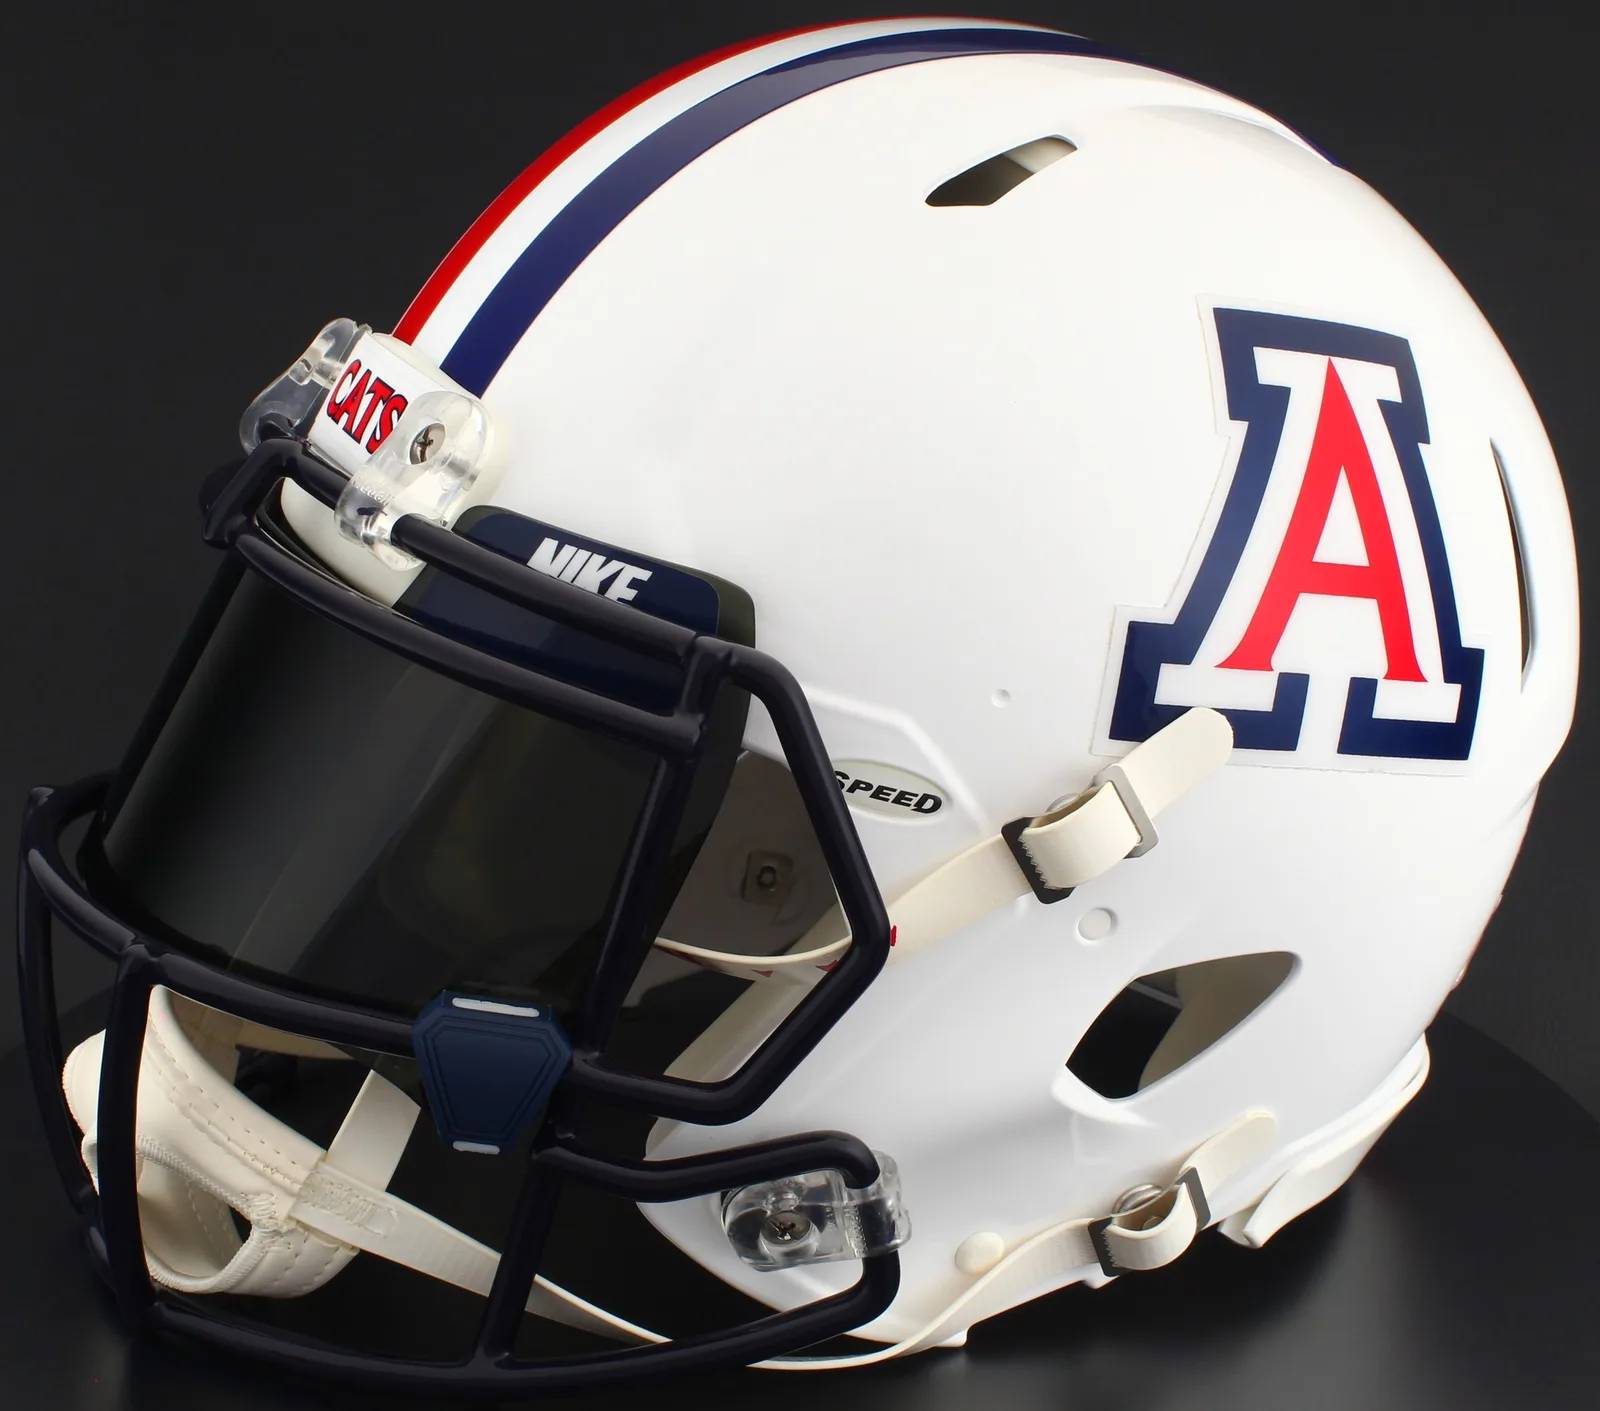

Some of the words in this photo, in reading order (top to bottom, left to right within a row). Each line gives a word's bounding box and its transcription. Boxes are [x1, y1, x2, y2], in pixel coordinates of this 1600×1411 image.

[326, 359, 409, 454] CATS
[527, 537, 653, 605] NIKE
[1109, 307, 1484, 760] A
